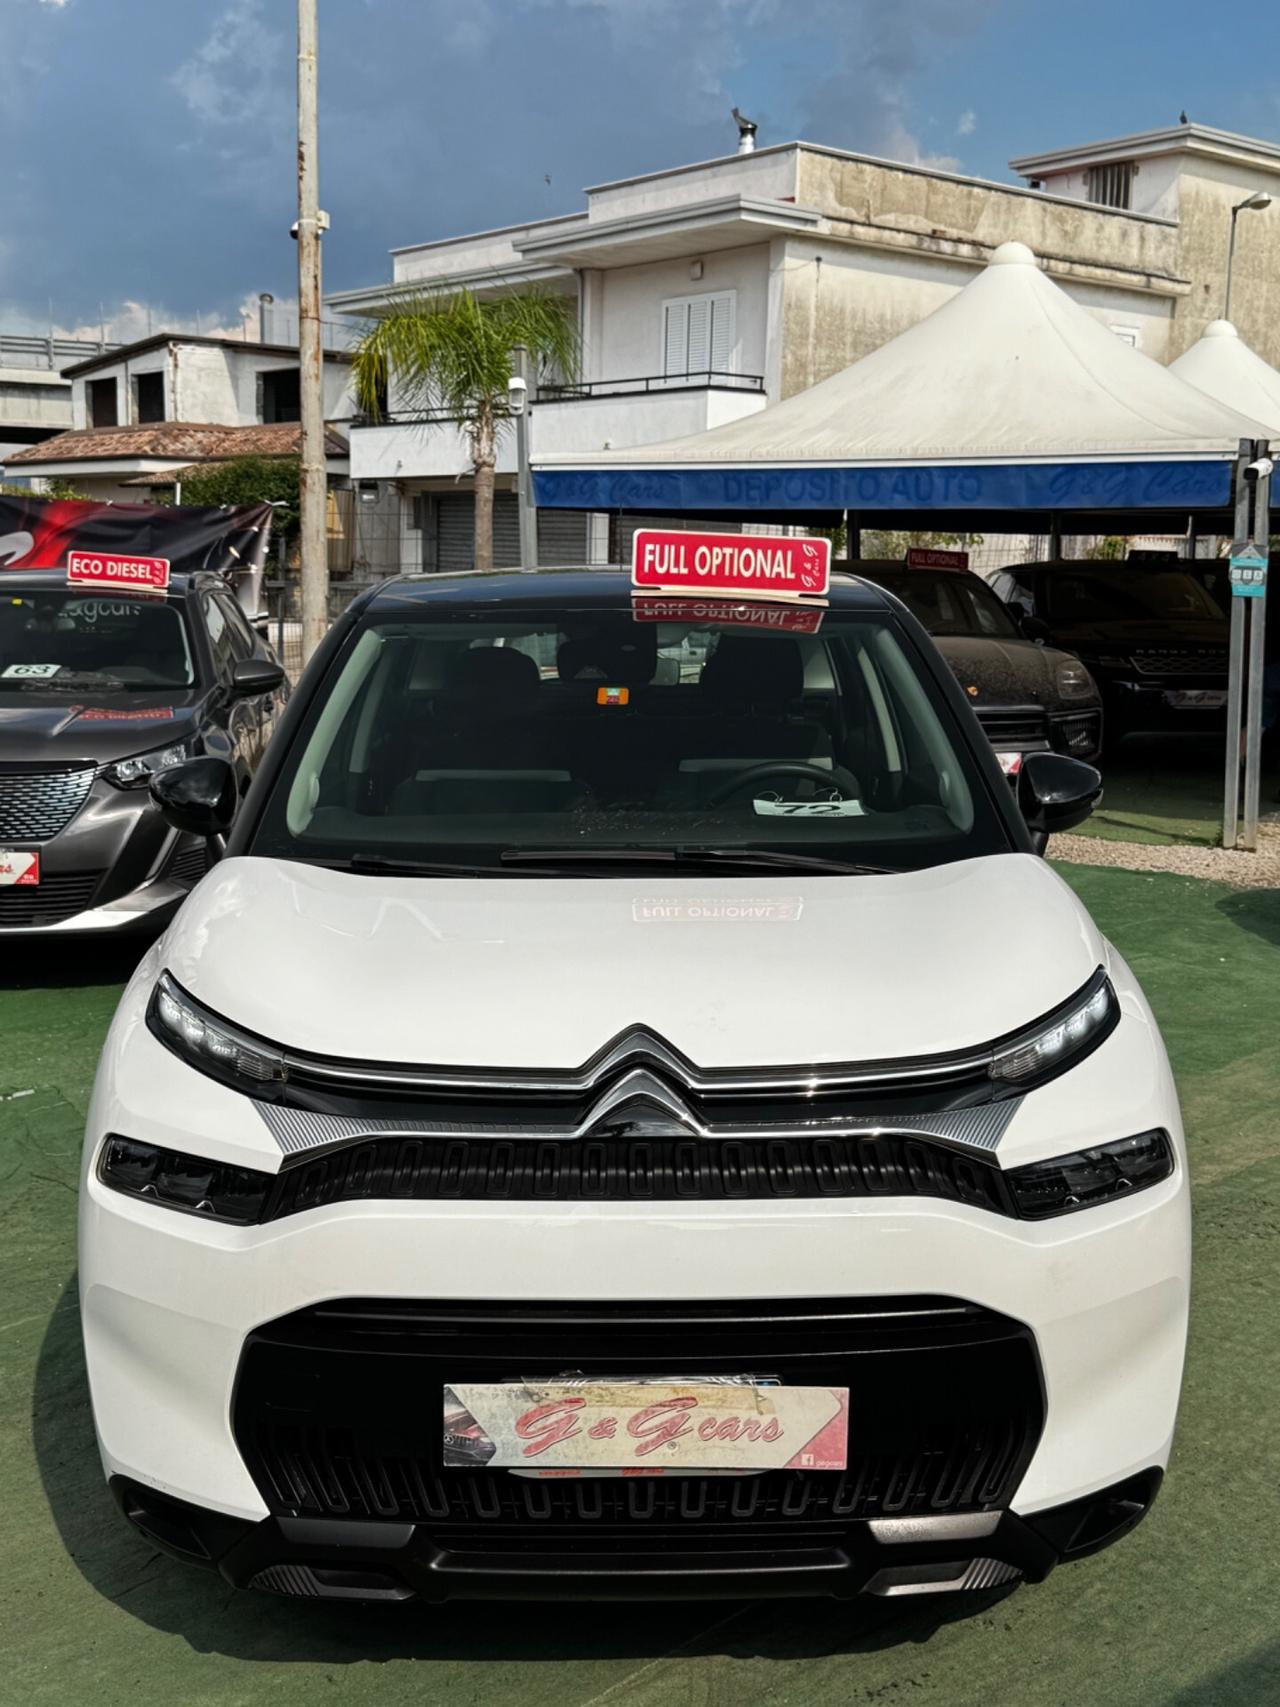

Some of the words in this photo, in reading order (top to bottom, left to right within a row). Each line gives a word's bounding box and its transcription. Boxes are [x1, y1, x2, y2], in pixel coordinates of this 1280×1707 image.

[722, 474, 881, 503] DEPOSITO
[891, 472, 983, 503] AUTO
[72, 558, 103, 575] ECO
[106, 561, 153, 579] DIESEL
[643, 543, 689, 575] FULL
[694, 545, 796, 580] OPTIONAL
[14, 665, 51, 676] 63
[774, 804, 841, 815] 72
[697, 1413, 785, 1442] cars
